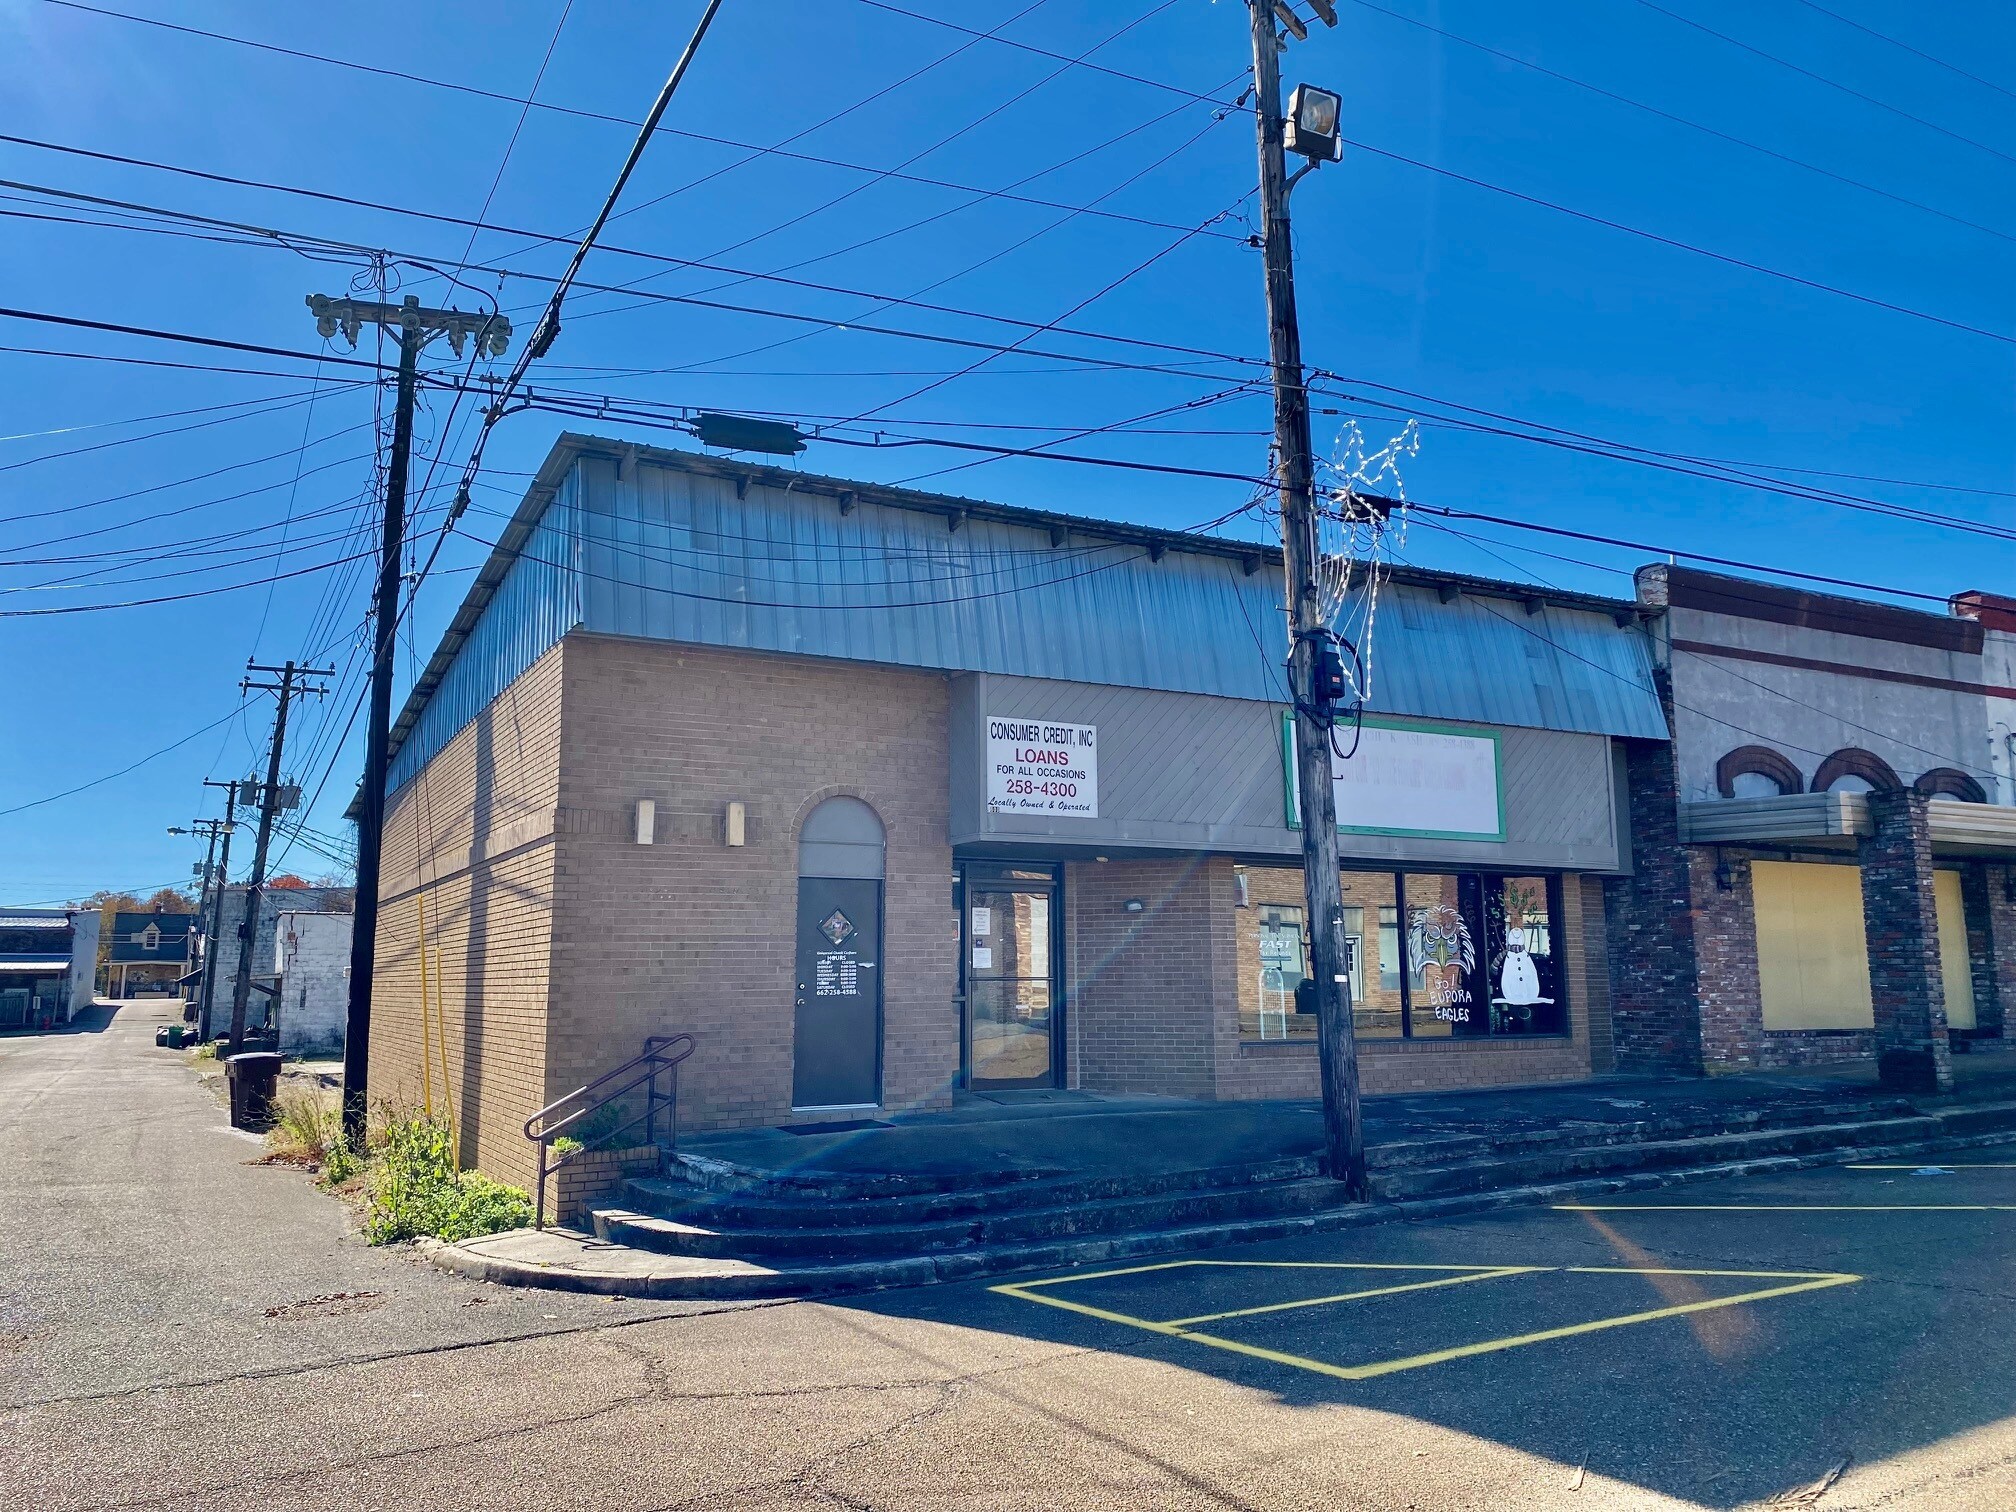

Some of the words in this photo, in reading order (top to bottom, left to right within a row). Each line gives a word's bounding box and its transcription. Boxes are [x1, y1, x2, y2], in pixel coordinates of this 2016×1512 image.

[990, 722, 1040, 742] CONSUMER
[1043, 726, 1076, 748] CREDIT,
[1078, 730, 1093, 747] INC
[1015, 748, 1069, 766] LOANS
[996, 764, 1015, 774] FOR
[1018, 766, 1033, 776] ALL
[1036, 767, 1086, 780] OCCASIONS
[1006, 779, 1077, 797] 258-4300
[988, 797, 1016, 807] Locally
[1020, 799, 1044, 808] Owned
[1048, 801, 1055, 809] &
[1058, 801, 1090, 811] Operated
[1259, 940, 1291, 948] FAST
[1429, 990, 1472, 1004] EUPORA
[1435, 1006, 1470, 1022] EAGLES
